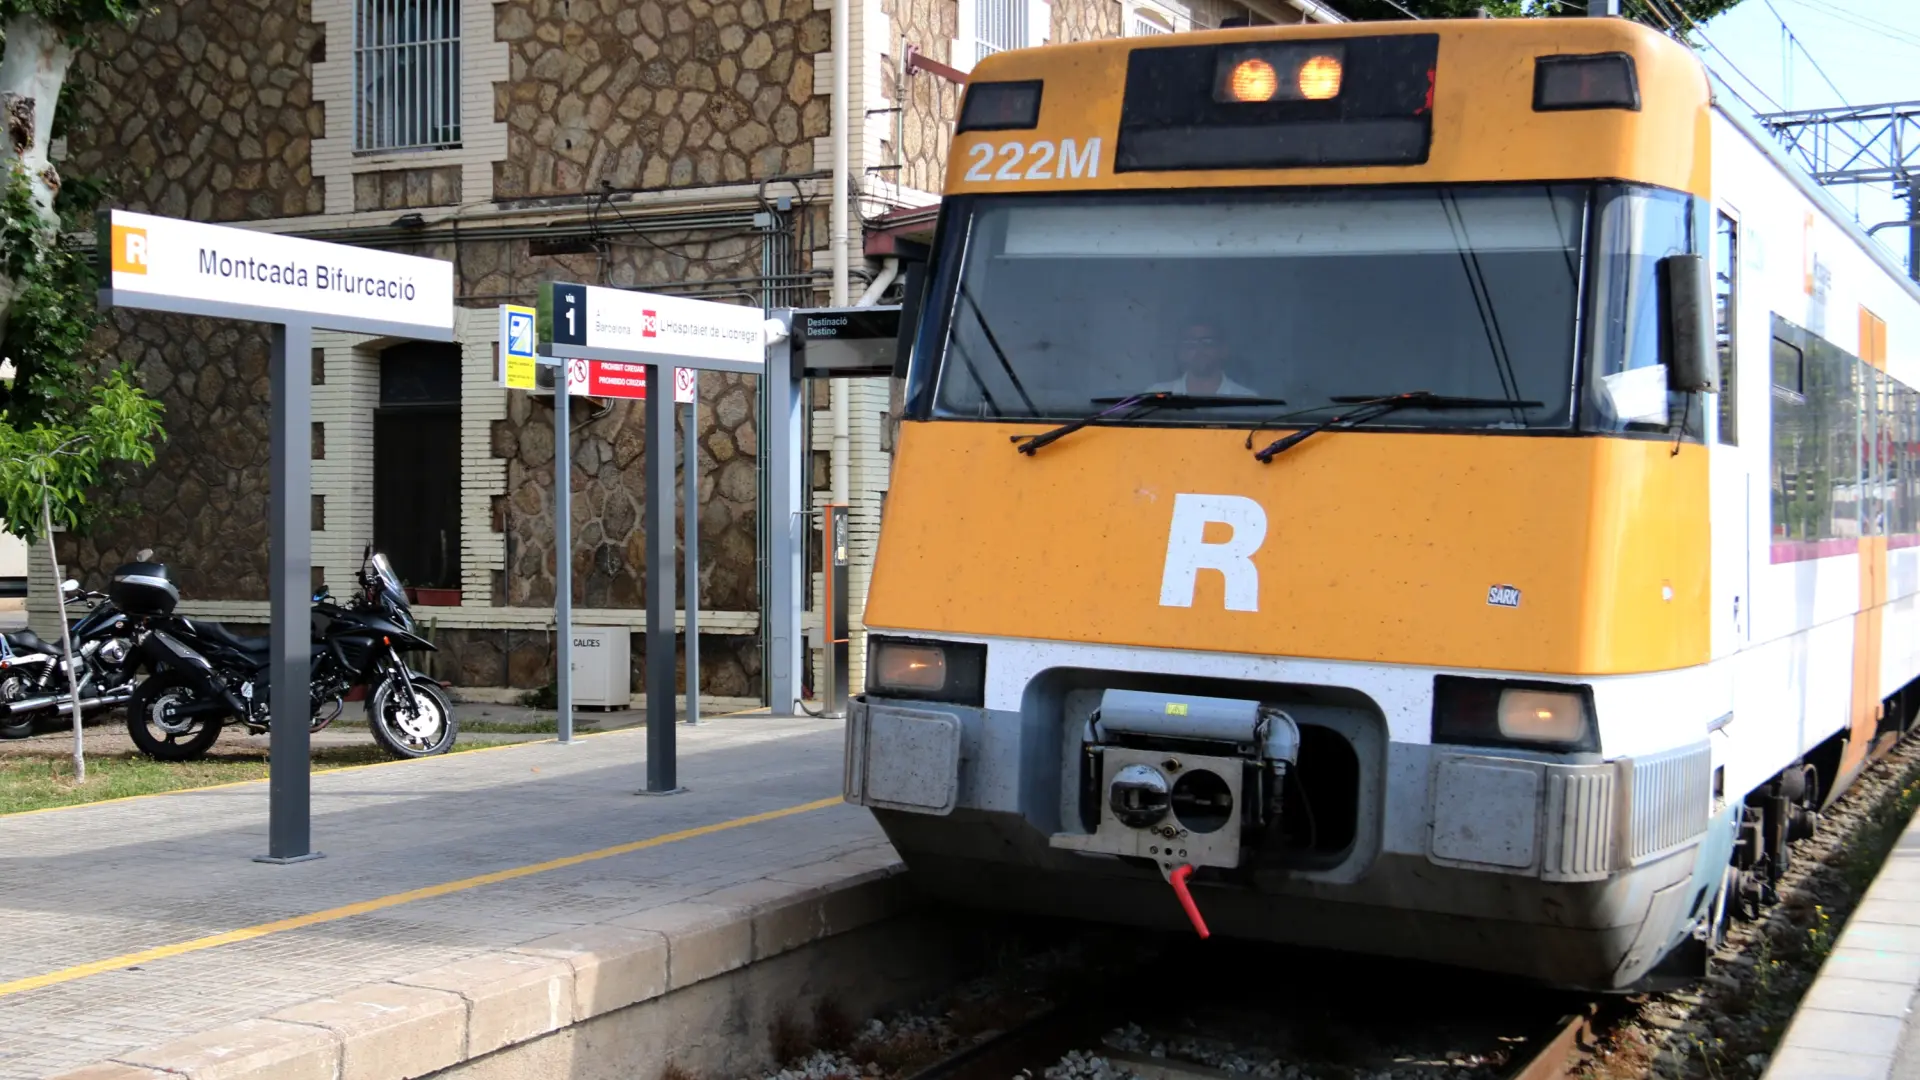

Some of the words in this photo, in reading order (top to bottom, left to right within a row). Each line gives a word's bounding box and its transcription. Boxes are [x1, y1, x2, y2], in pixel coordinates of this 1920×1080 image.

[963, 137, 1101, 182] 222M
[125, 232, 148, 265] R
[199, 248, 309, 288] Montcada
[315, 265, 416, 301] Bifurcació
[565, 307, 575, 336] 1
[595, 320, 631, 335] Barcelona
[660, 319, 708, 337] LHospitalet
[709, 324, 720, 338] de
[807, 317, 848, 326] Destinació
[807, 328, 837, 336] Destino
[1158, 493, 1268, 612] R
[1488, 587, 1519, 606] SARK
